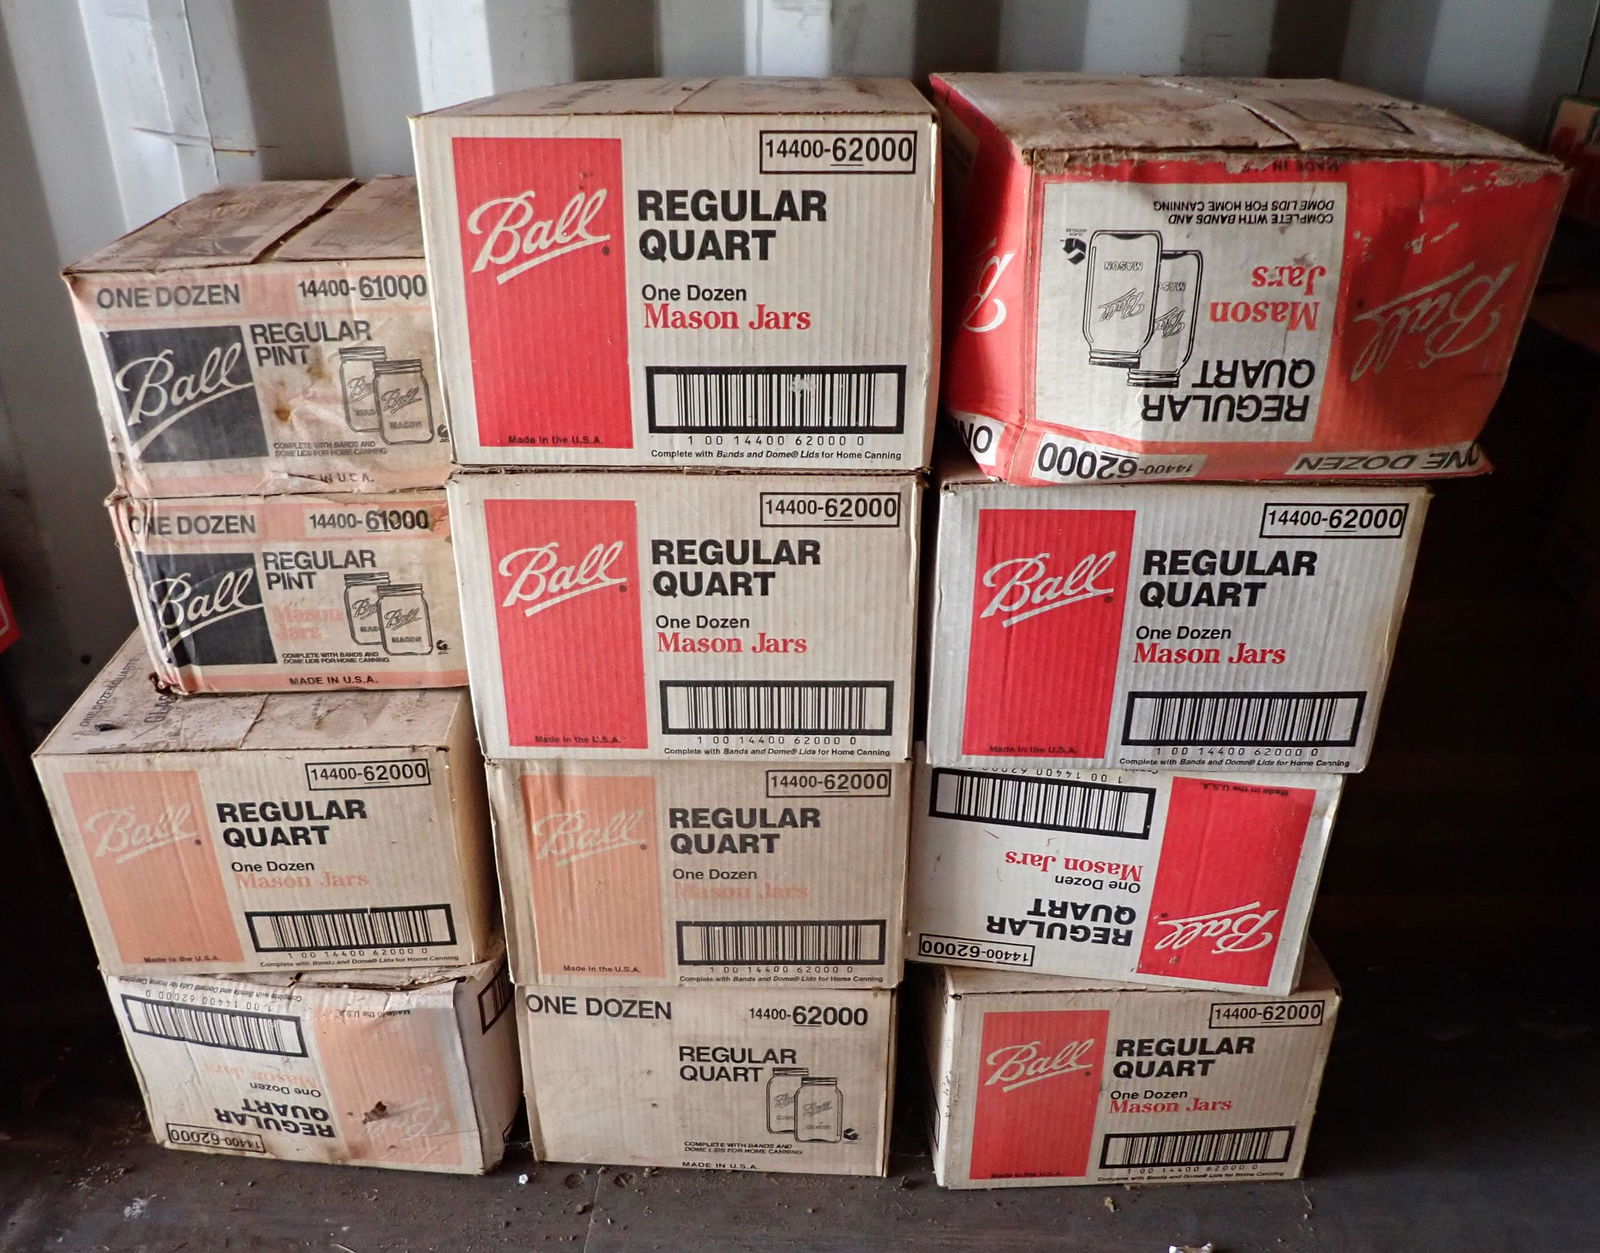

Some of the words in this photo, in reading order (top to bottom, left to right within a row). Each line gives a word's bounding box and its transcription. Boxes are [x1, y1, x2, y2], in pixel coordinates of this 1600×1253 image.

[765, 136, 913, 163] 14400-62000
[637, 189, 826, 222] REGULAR
[1154, 201, 1205, 210] CANNING
[1209, 201, 1242, 210] HOME
[1245, 200, 1268, 210] FOR
[1272, 200, 1297, 210] LIDS
[1299, 200, 1334, 210] DOME
[1168, 214, 1191, 224] AND
[1196, 214, 1235, 224] BANDS
[1239, 214, 1267, 224] WITH
[1271, 213, 1333, 224] COMPLETE
[468, 189, 610, 285] Ball
[638, 228, 776, 262] QUART
[298, 274, 426, 299] 14400-61000
[1252, 266, 1326, 296] Jars
[97, 287, 152, 309] ONE
[155, 283, 240, 307] DOZEN
[641, 285, 680, 301] One
[686, 285, 747, 302] Dozen
[643, 303, 739, 329] Mason
[749, 304, 811, 330] Jars
[1210, 301, 1320, 331] Mason
[1350, 261, 1517, 382] Ball
[250, 320, 372, 344] REGULAR
[255, 345, 309, 367] PINT
[1192, 358, 1315, 388] QUART
[115, 342, 254, 457] Ball
[1141, 394, 1309, 422] REGULAR
[651, 449, 692, 458] Complete
[694, 449, 713, 458] with
[746, 450, 763, 458] and
[835, 451, 862, 459] Home
[864, 451, 902, 461] Canning
[1037, 442, 1193, 480] 14400-62000
[1295, 454, 1418, 470] DOZEN
[765, 497, 897, 518] 14400-62000
[177, 515, 256, 535] DOZEN
[1265, 508, 1405, 530] 14400-62000
[262, 550, 376, 571] REGULAR
[650, 539, 820, 565] REGULAR
[1142, 549, 1319, 576] REGULAR
[266, 572, 316, 590] PINT
[498, 540, 627, 616] Ball
[651, 570, 775, 597] QUART
[979, 550, 1115, 626] Ball
[1137, 581, 1267, 608] QUART
[150, 568, 264, 651] Ball
[654, 616, 690, 629] One
[695, 615, 750, 629] Dozen
[656, 630, 743, 651] Mason
[751, 631, 807, 652] Jars
[1133, 626, 1170, 639] One
[1174, 626, 1232, 640] Dozen
[1132, 641, 1223, 663] Mason
[1228, 642, 1288, 663] Jars
[289, 677, 322, 685] MADE
[309, 763, 427, 782] 14400-62000
[770, 773, 888, 790] 14400-62000
[215, 799, 367, 822] REGULAR
[668, 808, 820, 828] REGULAR
[85, 802, 200, 863] Ball
[221, 825, 333, 847] QUART
[532, 806, 646, 868] Ball
[669, 833, 780, 854] QUART
[230, 861, 263, 872] One
[266, 860, 315, 871] Dozen
[1003, 851, 1056, 872] Jars
[1062, 857, 1143, 881] Mason
[235, 871, 314, 889] Mason
[318, 869, 370, 886] Jars
[672, 869, 704, 879] One
[708, 869, 757, 880] Dozen
[1054, 875, 1104, 890] Dozen
[674, 881, 751, 897] Mason
[758, 881, 809, 897] Jars
[1107, 880, 1141, 893] One
[1026, 895, 1138, 926] QUART
[986, 914, 1133, 947] REGULAR
[1154, 901, 1279, 954] Ball
[920, 938, 1030, 964] 14400-62000
[526, 994, 577, 1015] ONE
[586, 997, 672, 1020] DOZEN
[749, 1006, 868, 1026] 14400-62000
[1213, 1004, 1323, 1020] 14400-62000
[679, 1046, 797, 1065] REGULAR
[1114, 1037, 1256, 1056] REGULAR
[680, 1065, 763, 1082] QUART
[984, 1038, 1094, 1092] Ball
[1111, 1059, 1215, 1078] QUART
[250, 1082, 290, 1094] Dozen
[294, 1088, 321, 1097] One
[1109, 1090, 1139, 1099] One
[1142, 1089, 1188, 1099] Dozen
[242, 1098, 329, 1121] QUART
[1107, 1098, 1180, 1113] Mason
[1185, 1097, 1233, 1111] Jars
[214, 1108, 335, 1137] REGULAR
